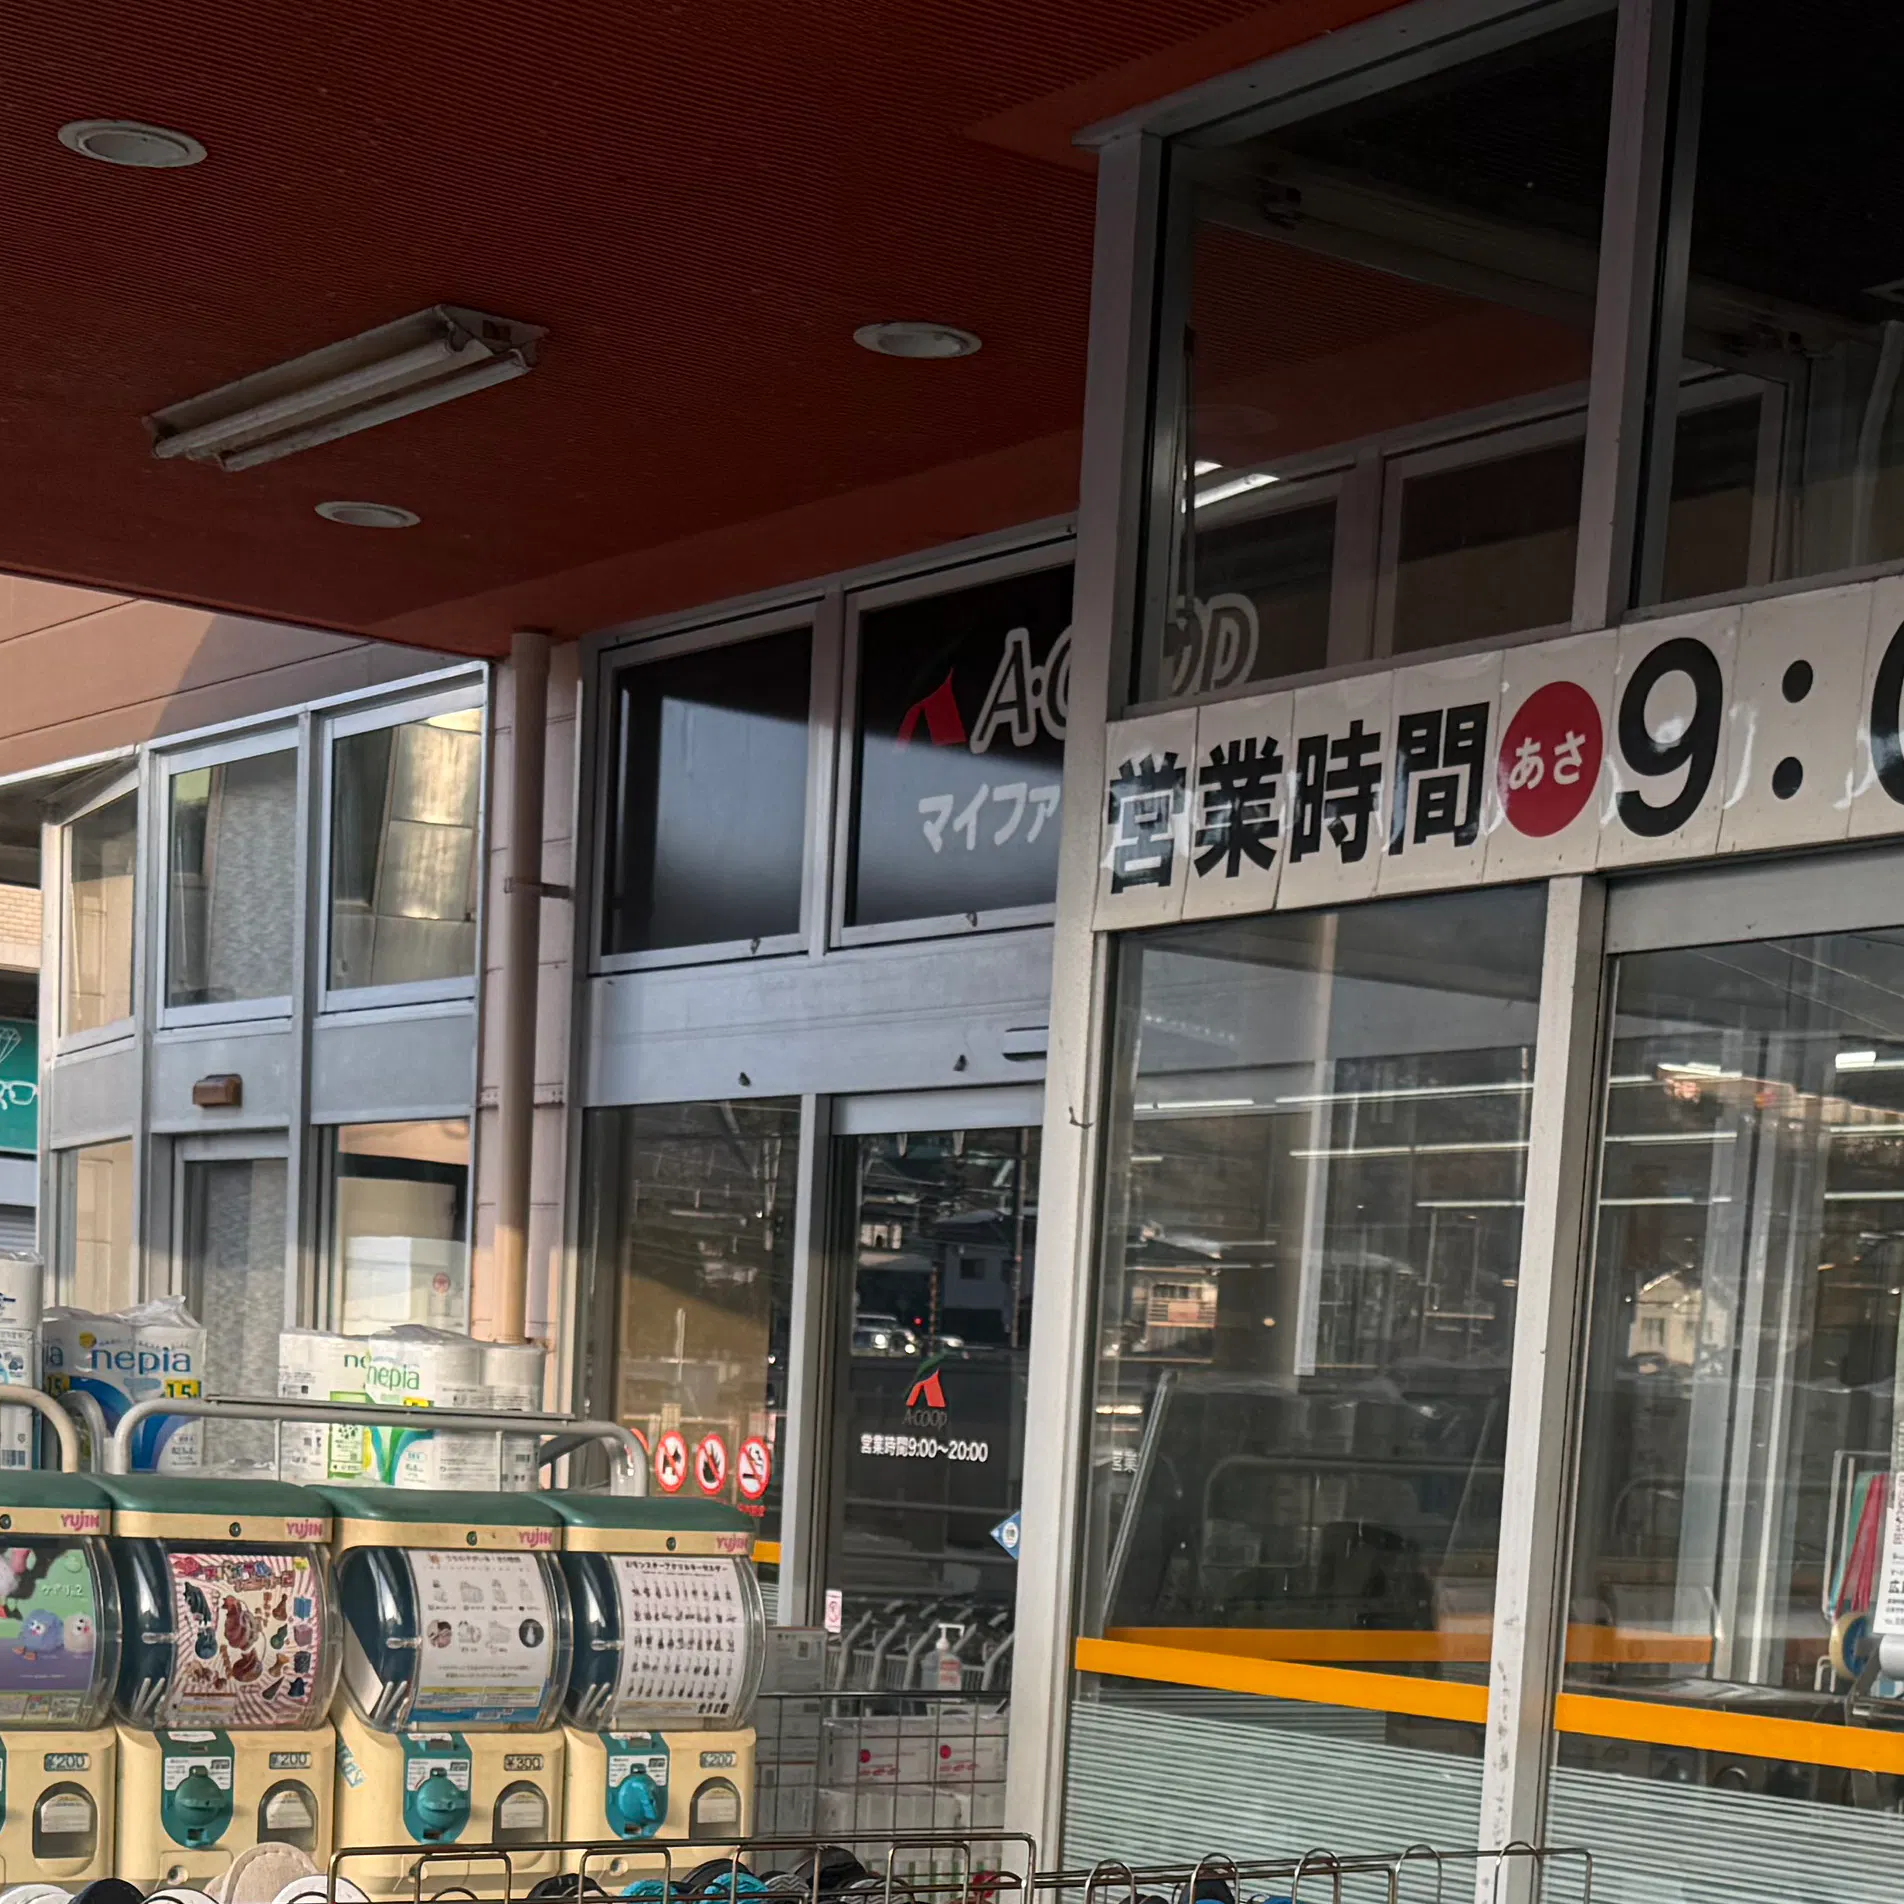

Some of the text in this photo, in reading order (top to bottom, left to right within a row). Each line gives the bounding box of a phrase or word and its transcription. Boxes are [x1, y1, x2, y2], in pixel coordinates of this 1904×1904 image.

[1108, 701, 1491, 896] 営業時間
[1509, 730, 1589, 792] あさ
[91, 1347, 191, 1375] nepia
[367, 1363, 420, 1391] nepia
